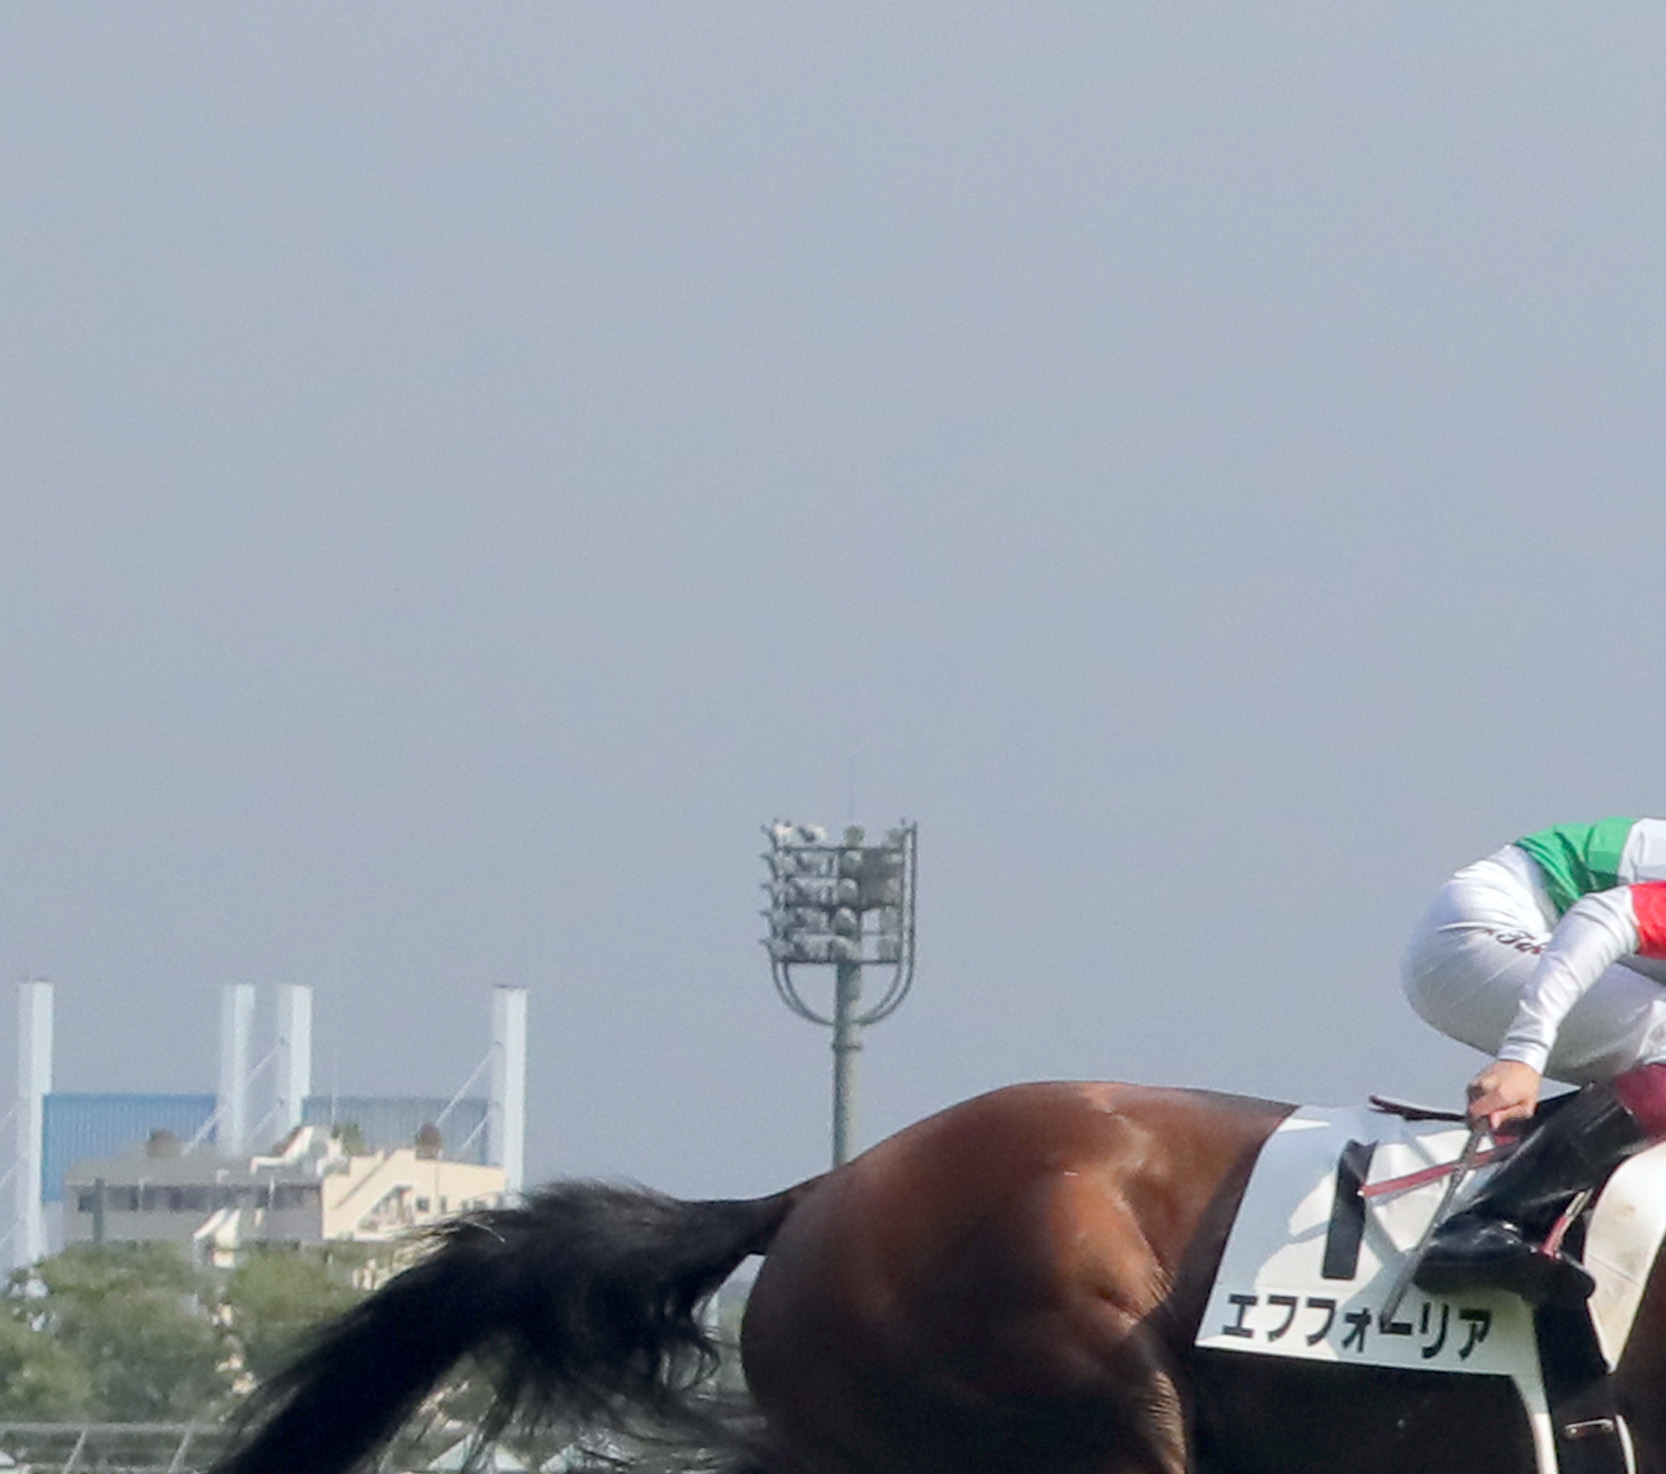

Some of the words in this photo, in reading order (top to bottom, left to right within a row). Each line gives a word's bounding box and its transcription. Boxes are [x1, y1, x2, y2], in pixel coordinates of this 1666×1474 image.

[1320, 1140, 1379, 1281] 1
[1221, 1293, 1493, 1360] エフフォーリア
